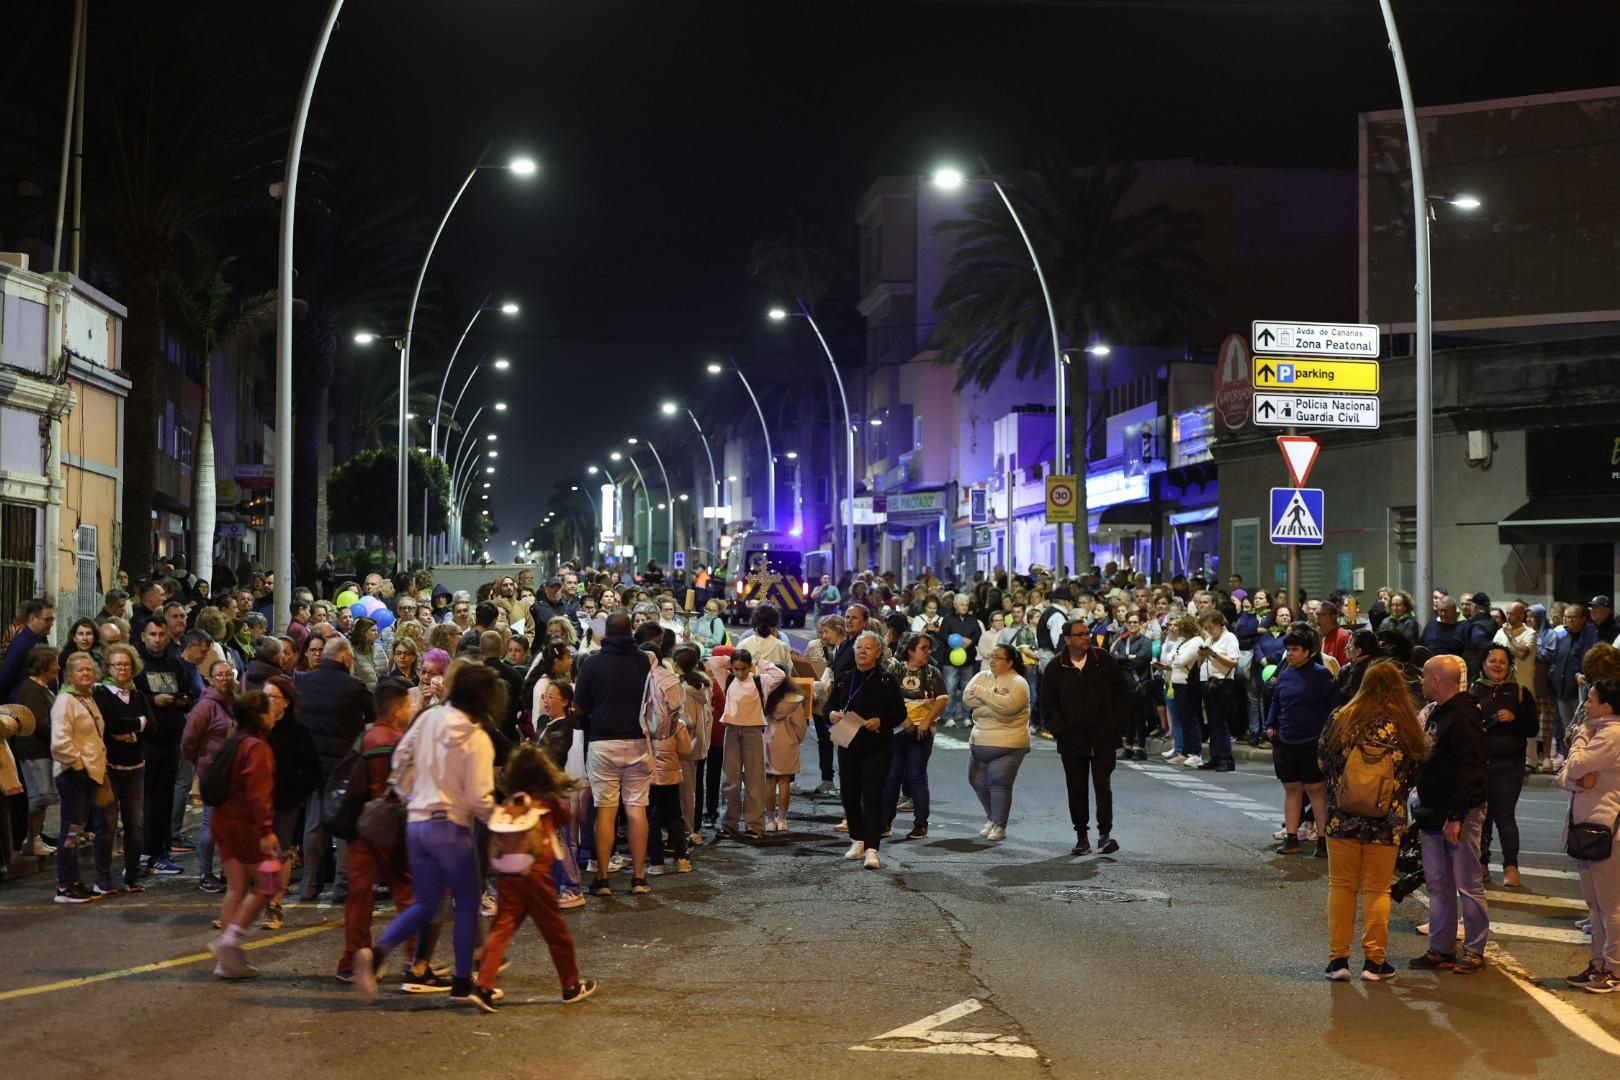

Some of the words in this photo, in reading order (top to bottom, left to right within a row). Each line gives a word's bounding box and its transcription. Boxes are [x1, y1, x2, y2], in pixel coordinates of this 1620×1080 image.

[1319, 328, 1329, 336] de
[1331, 328, 1364, 337] Canarias
[1295, 338, 1321, 349] Zona
[1325, 339, 1372, 351] Peatonal
[1279, 365, 1291, 381] P
[1295, 368, 1335, 381] parking
[1332, 399, 1375, 411] Nacional
[1296, 410, 1334, 422] Guardia
[1338, 412, 1360, 423] Civil
[1055, 491, 1068, 500] 30
